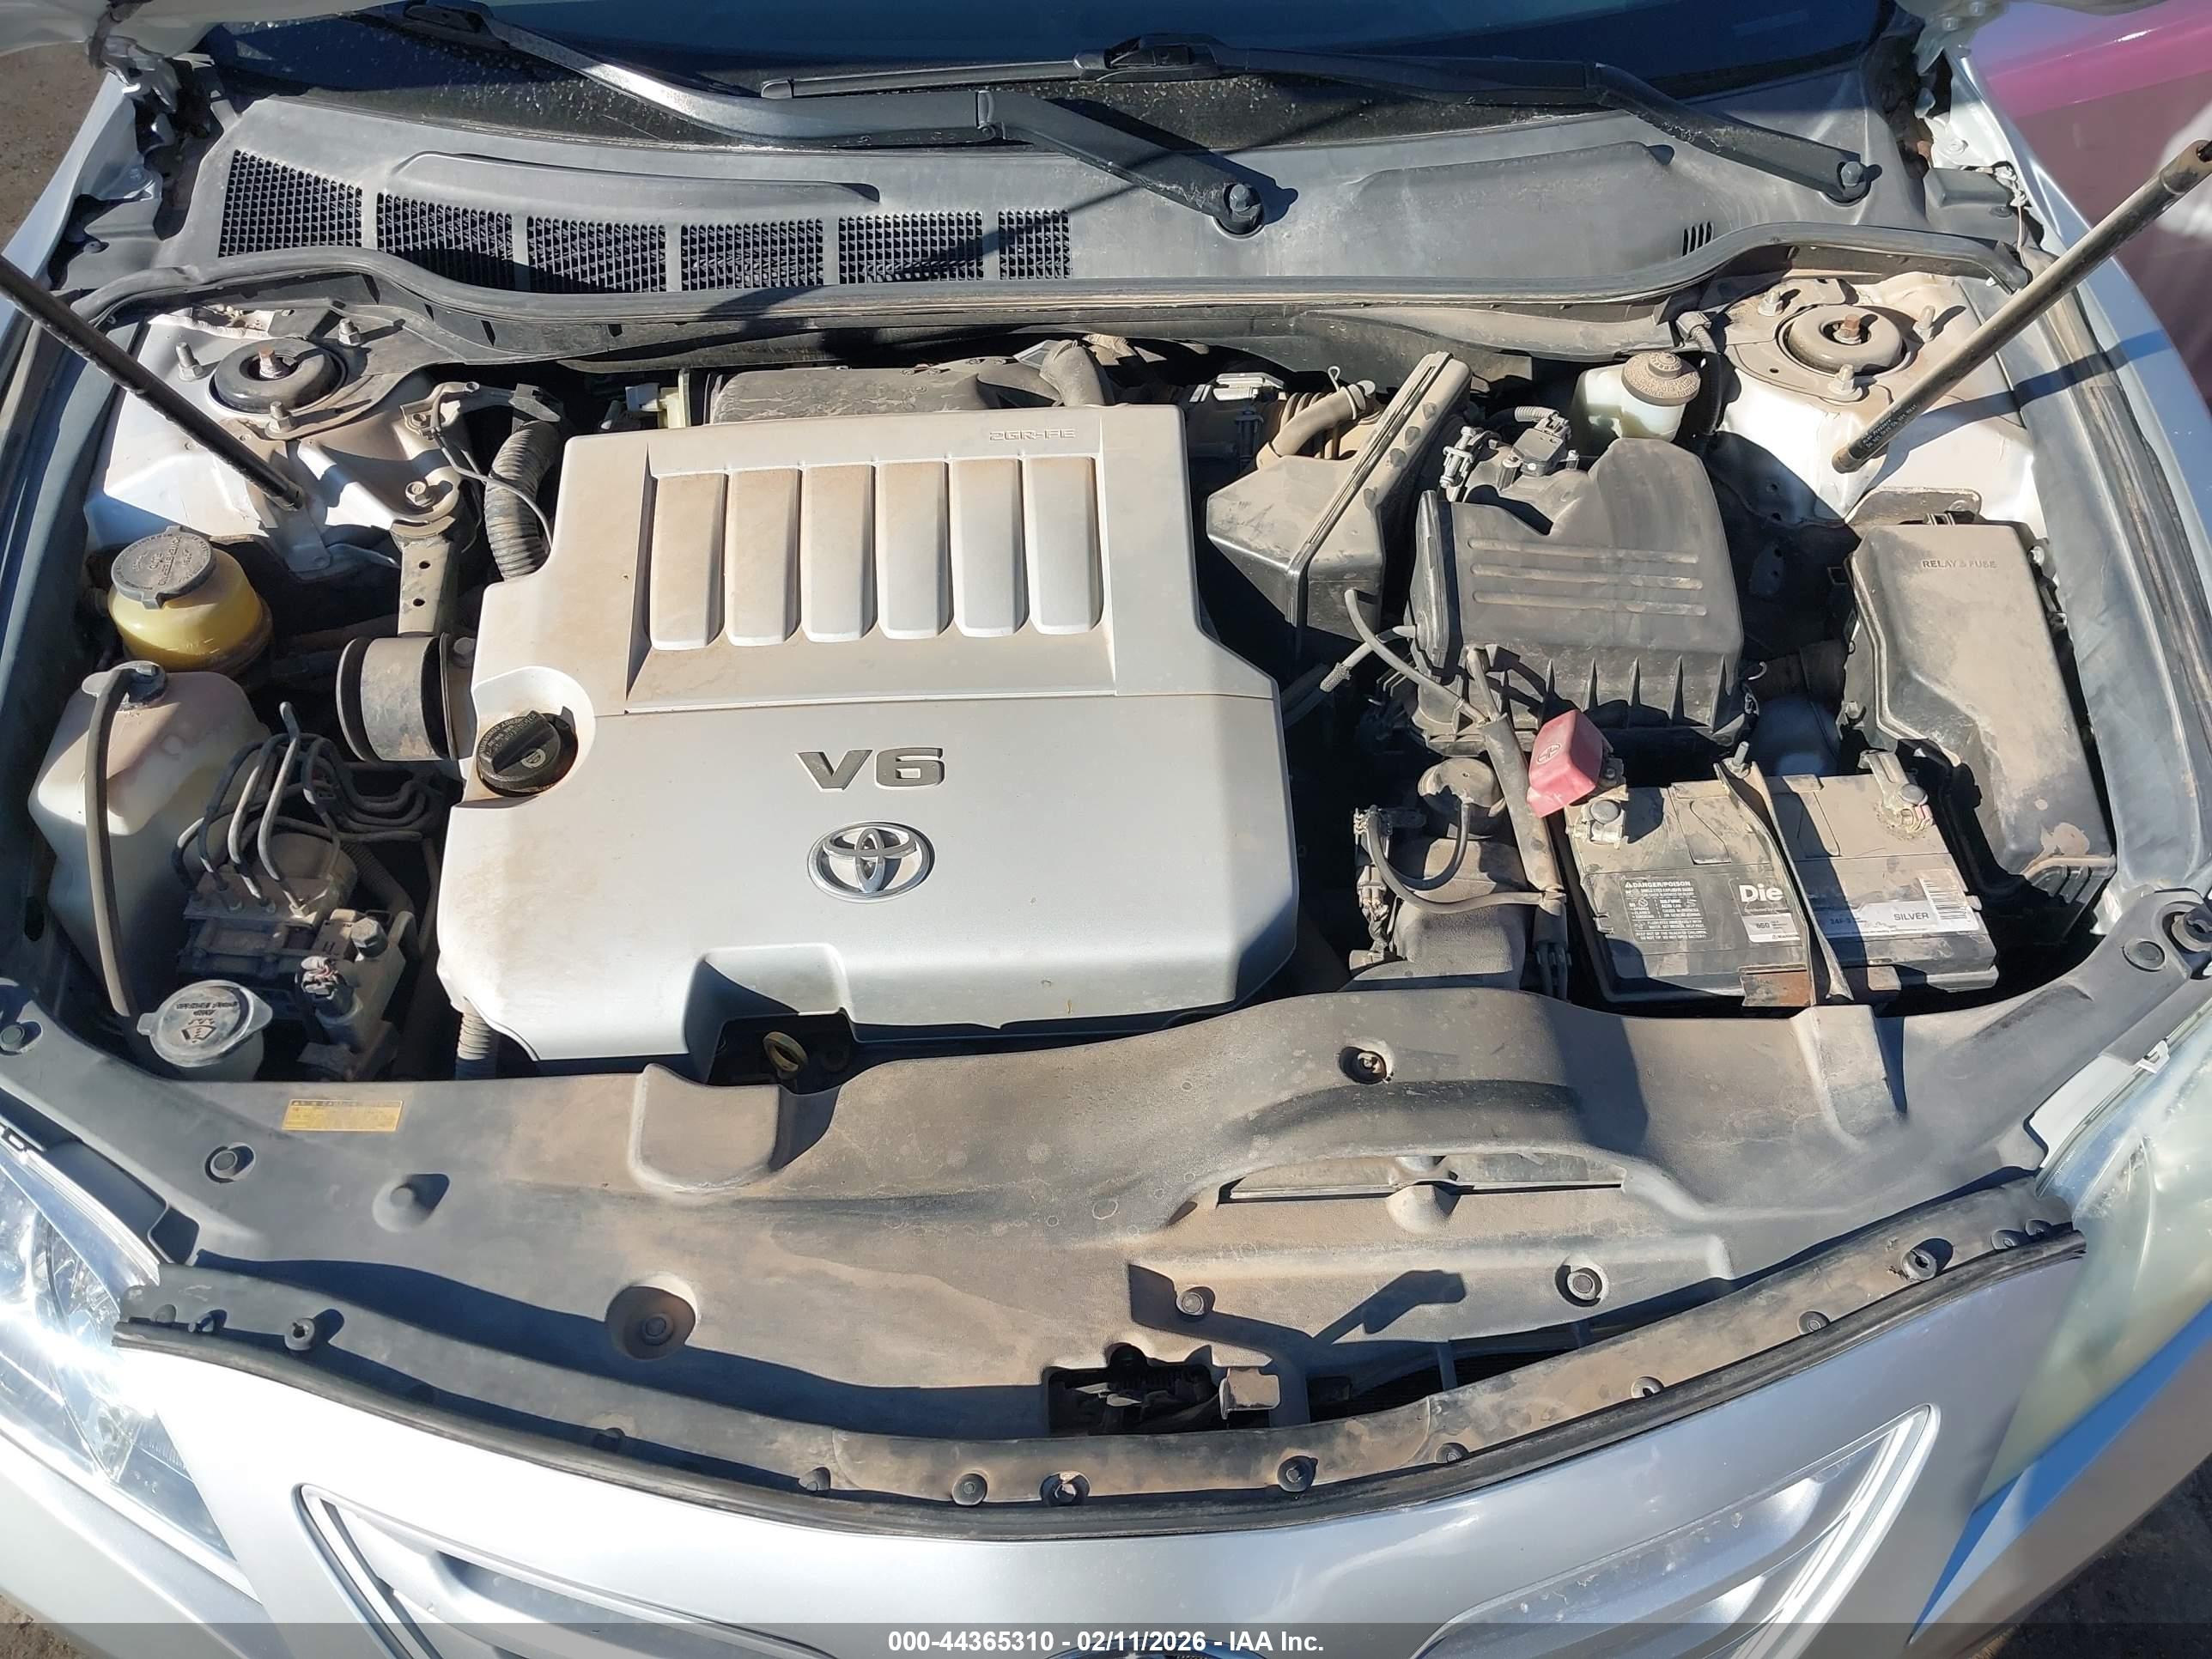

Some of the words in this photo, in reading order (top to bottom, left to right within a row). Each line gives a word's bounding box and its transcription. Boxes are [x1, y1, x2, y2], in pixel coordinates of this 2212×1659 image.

[989, 428, 1075, 441] 2GR-FE
[1922, 560, 1957, 568] RELAY
[795, 746, 945, 793] V6
[1893, 913, 1929, 921] SILVER
